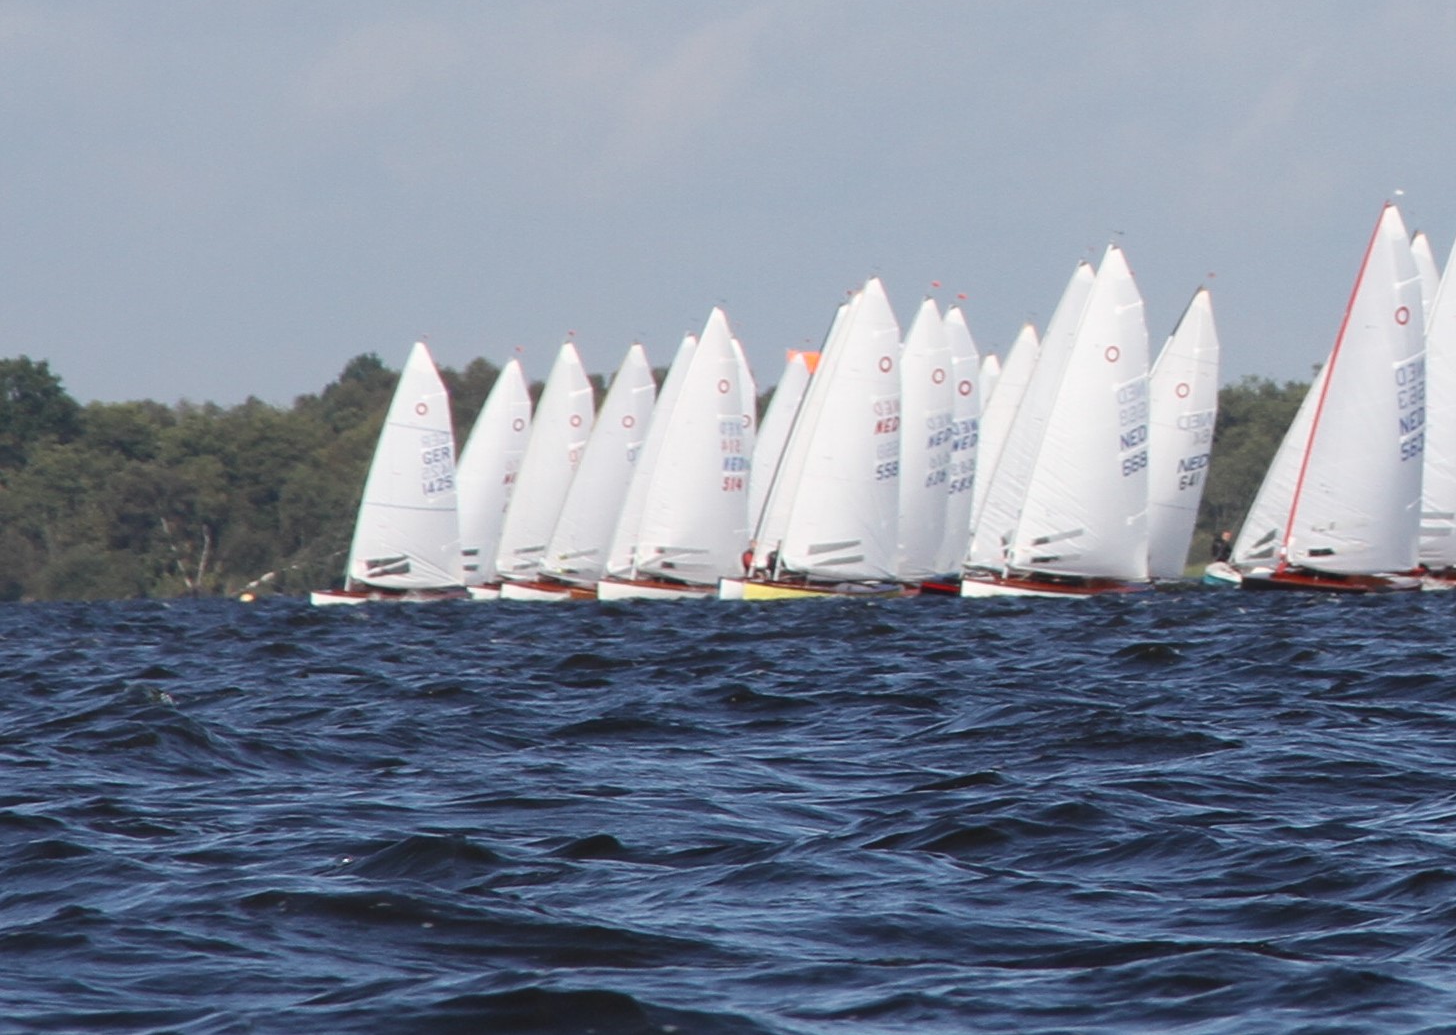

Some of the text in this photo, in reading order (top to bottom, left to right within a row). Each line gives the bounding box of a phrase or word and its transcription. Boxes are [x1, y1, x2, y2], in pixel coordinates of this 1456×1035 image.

[875, 416, 900, 434] NED
[1121, 425, 1148, 450] NED
[423, 447, 450, 465] GER
[1177, 454, 1210, 473] NED
